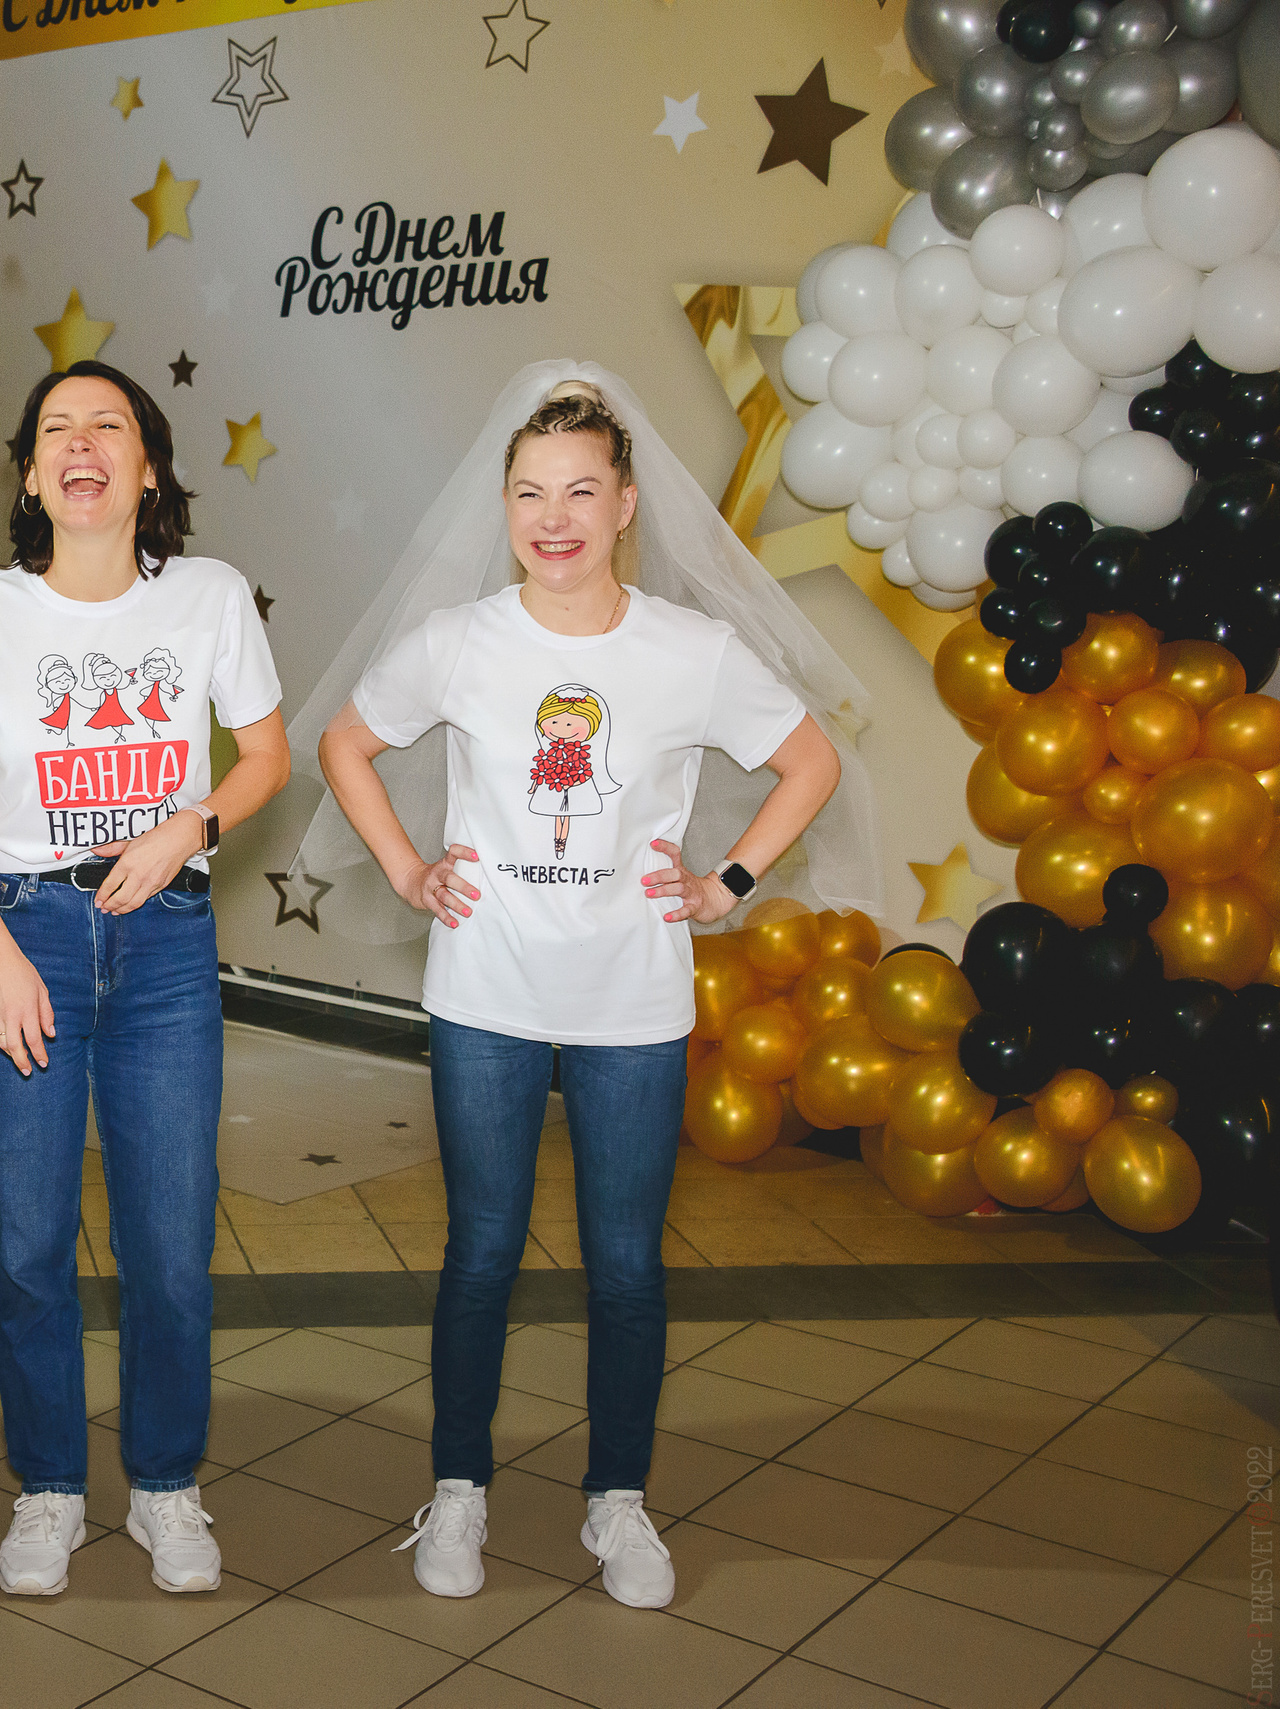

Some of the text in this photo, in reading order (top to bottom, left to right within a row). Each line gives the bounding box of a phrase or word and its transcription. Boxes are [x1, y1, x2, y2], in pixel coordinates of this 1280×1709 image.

[311, 201, 506, 270] С Днем
[275, 257, 549, 331] Рождения
[41, 745, 181, 804] БАНДА
[521, 864, 589, 886] НЕВЕСТА
